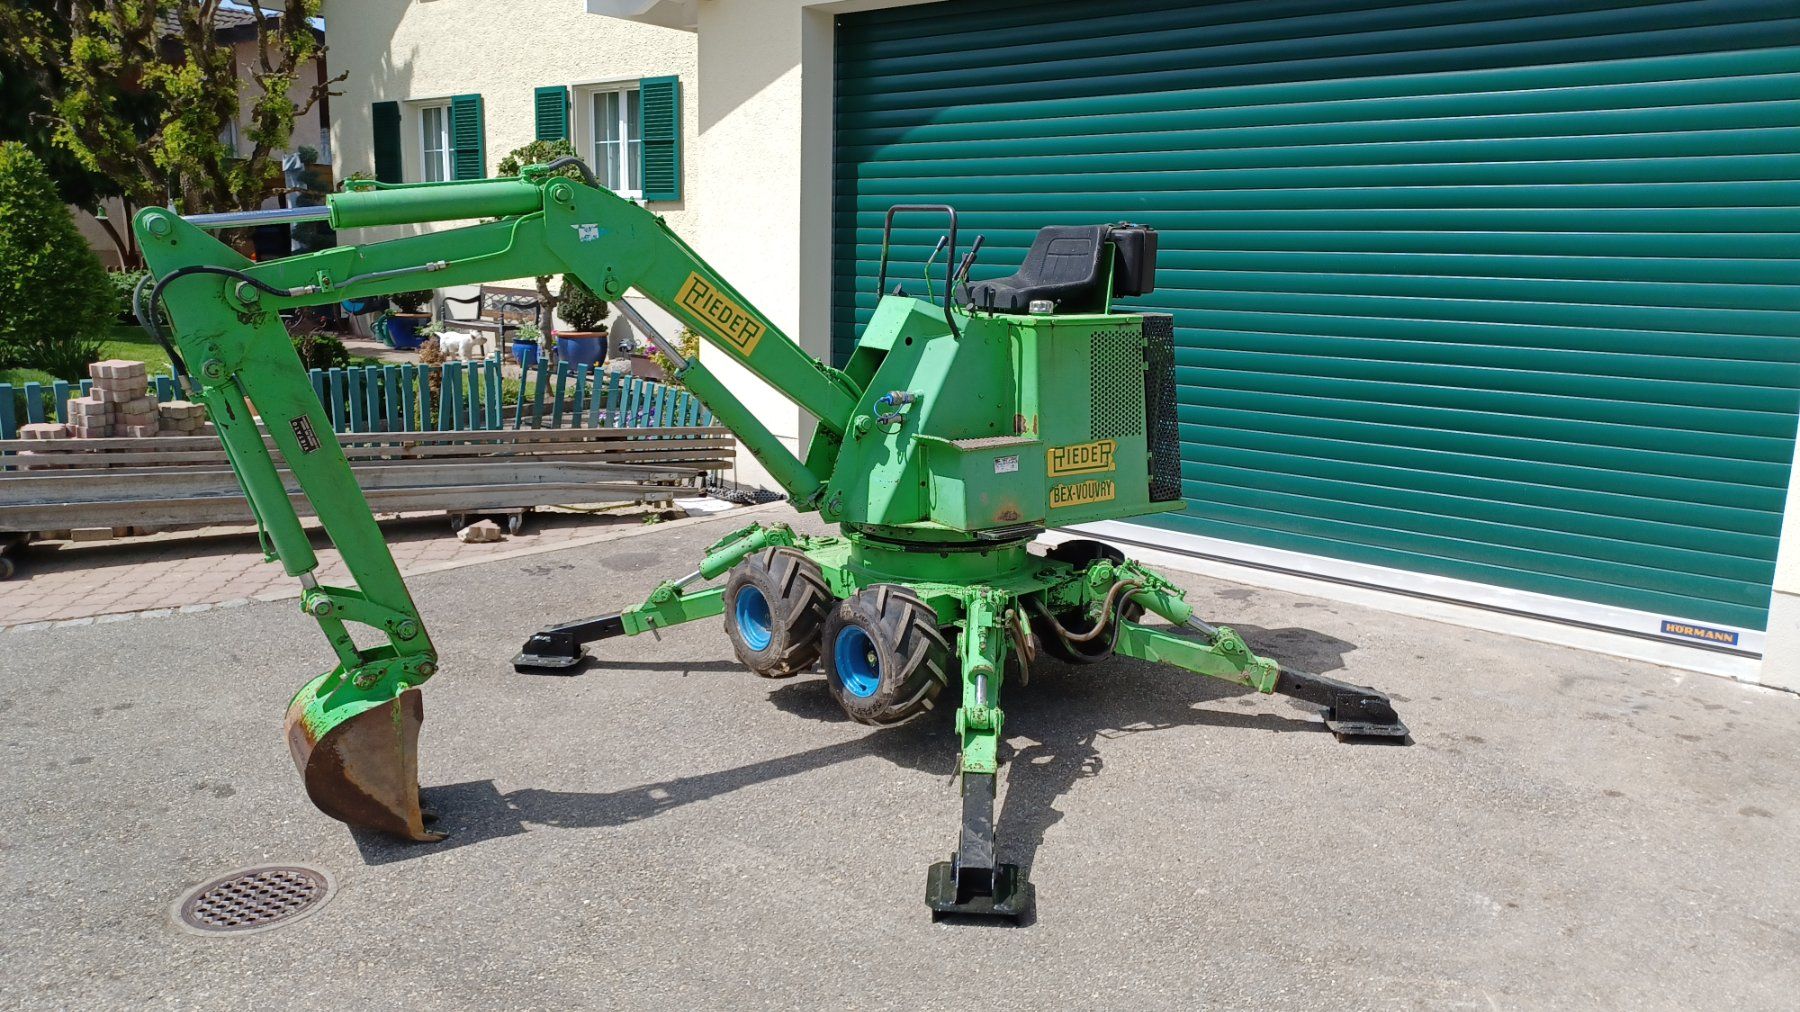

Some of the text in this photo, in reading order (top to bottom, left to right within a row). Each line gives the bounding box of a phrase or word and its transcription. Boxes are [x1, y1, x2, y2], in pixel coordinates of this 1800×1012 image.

[682, 276, 760, 348] RIEDER
[1053, 442, 1112, 473] RIEDER
[1053, 481, 1112, 503] BEX-VOUVRY
